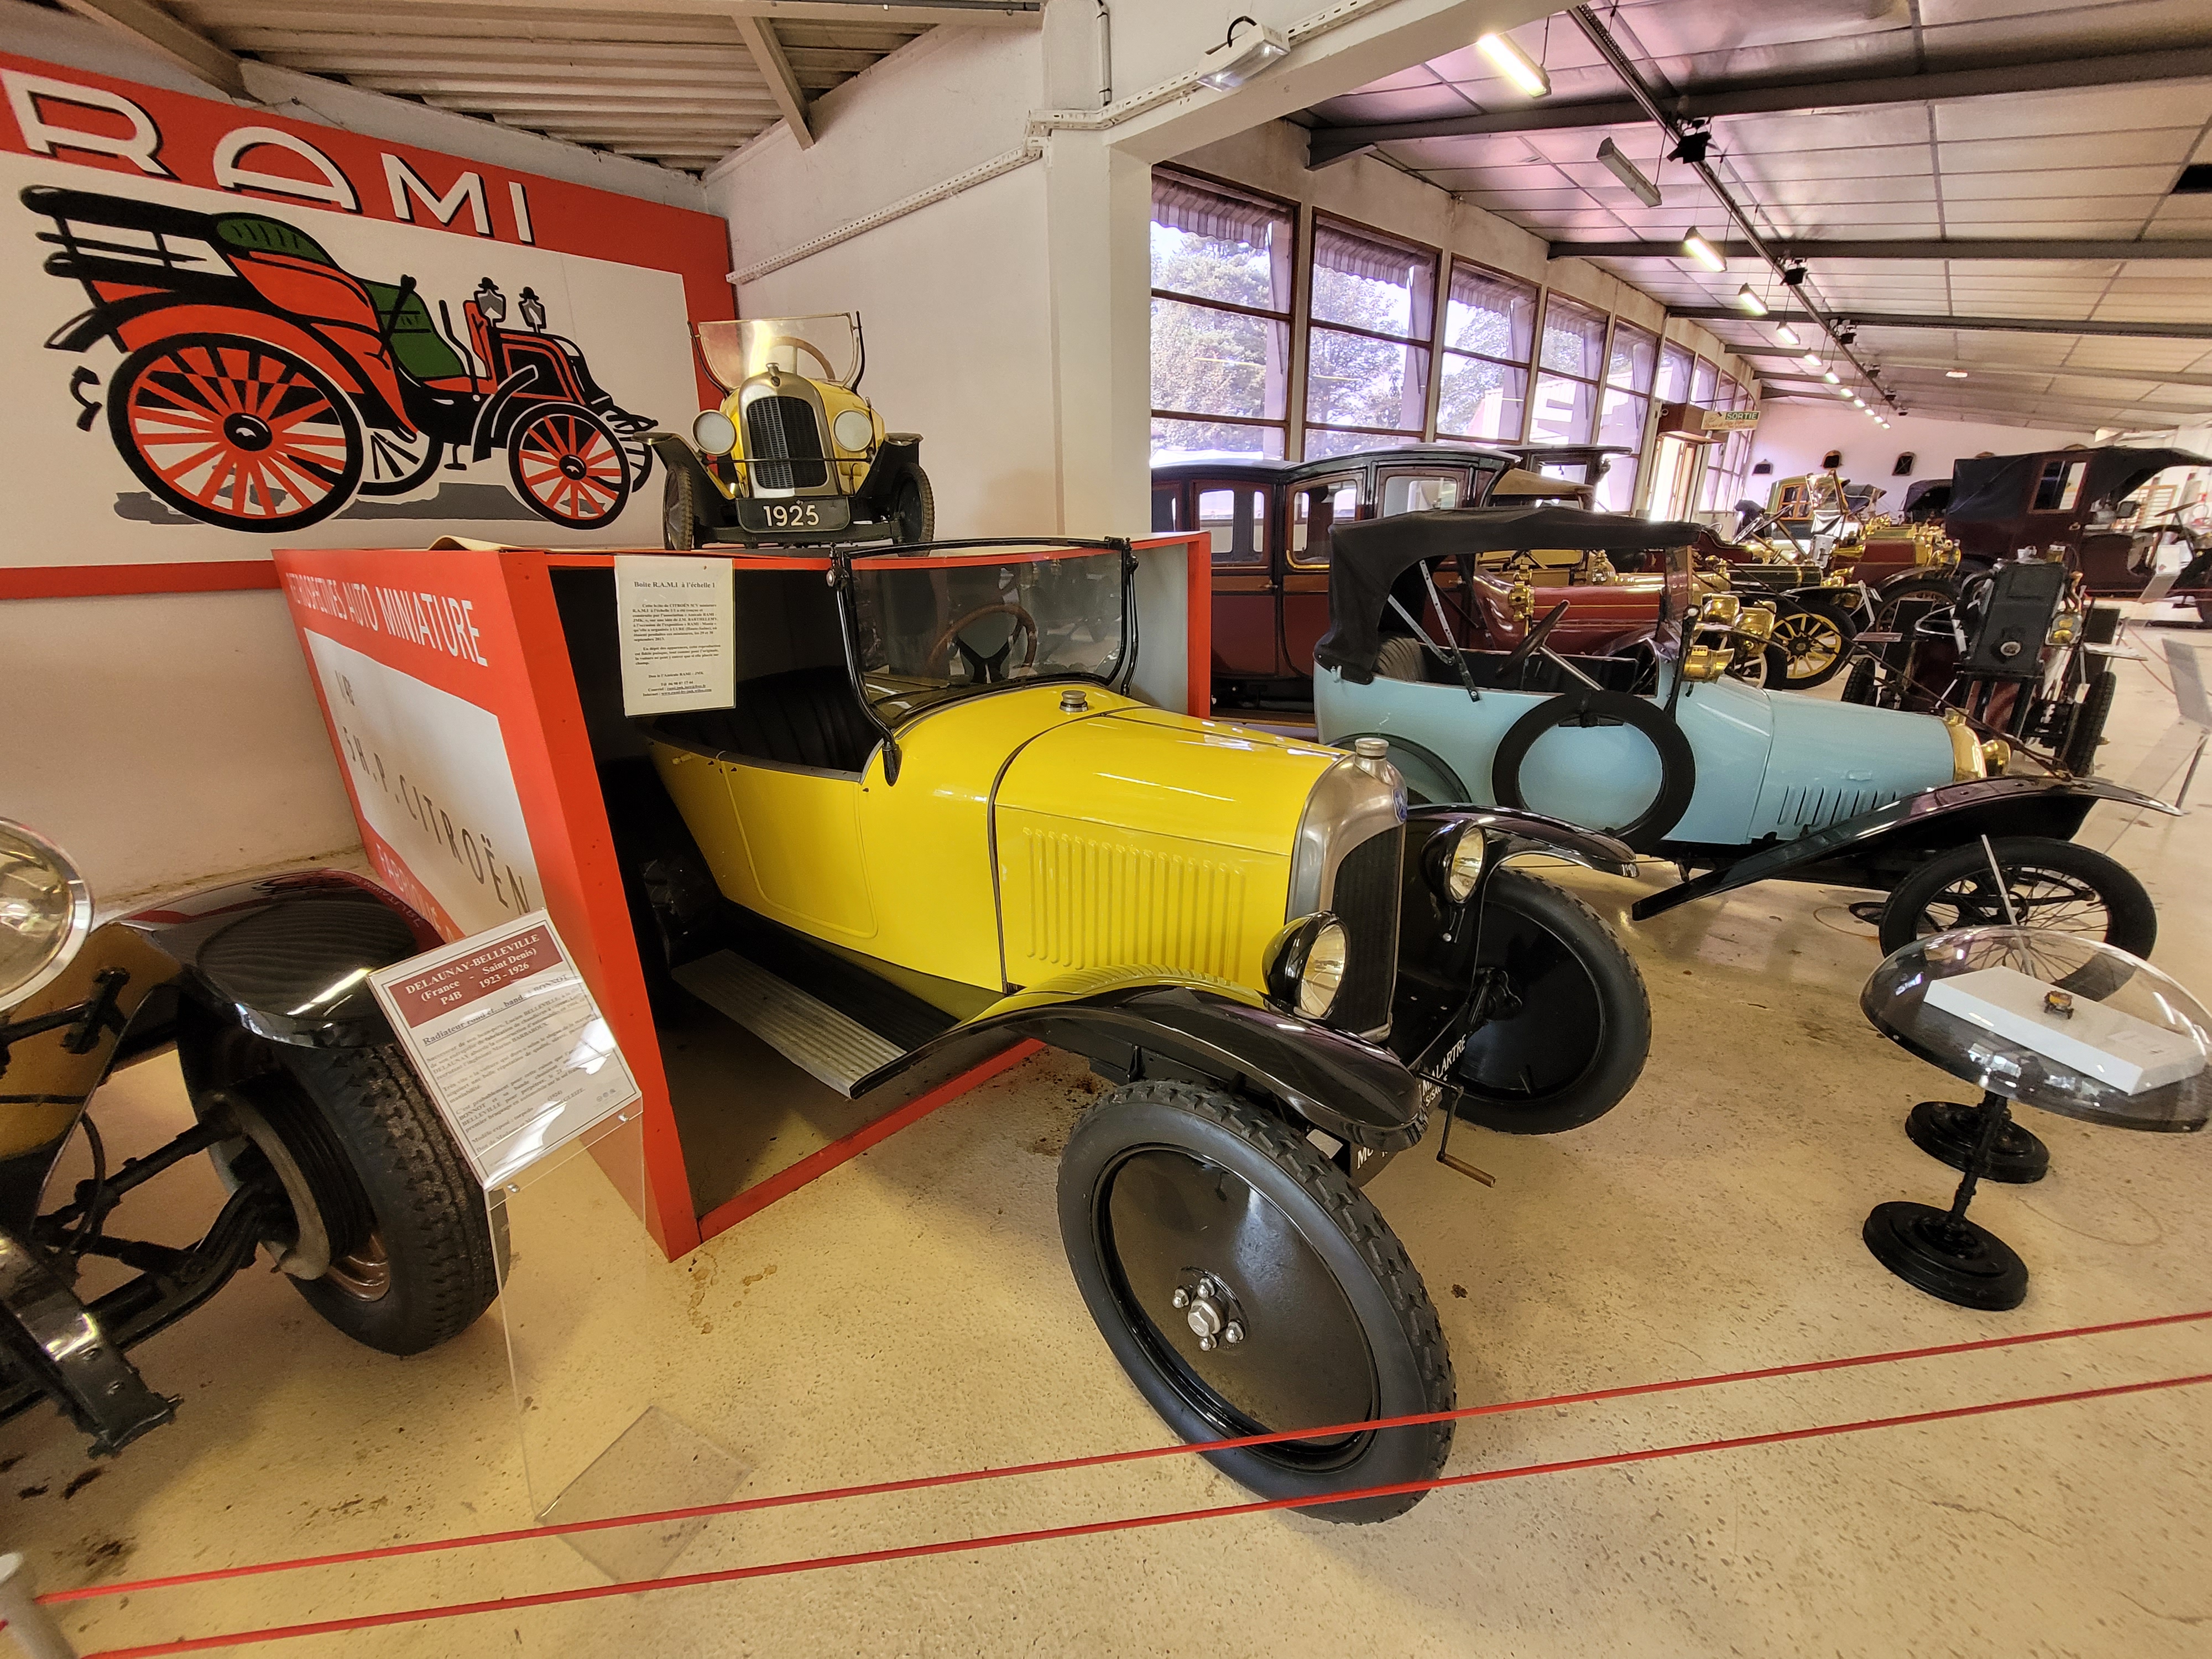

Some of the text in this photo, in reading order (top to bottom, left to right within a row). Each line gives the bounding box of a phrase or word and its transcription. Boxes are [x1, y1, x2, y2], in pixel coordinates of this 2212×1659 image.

[1, 67, 535, 246] RAMI
[763, 505, 820, 526] 1925
[342, 581, 379, 631] AUTO
[375, 586, 488, 667] MINIATURE
[399, 774, 531, 916] CITROËN
[405, 934, 540, 994] DELAUNAY-BELLEVILLE
[421, 948, 536, 1001] (France Saint Denis)
[440, 962, 529, 1005] P4B 1923 1926
[422, 1022, 467, 1045] Radiateur
[458, 1103, 486, 1120] BONNOT
[462, 1102, 502, 1126] BELLEVILLE
